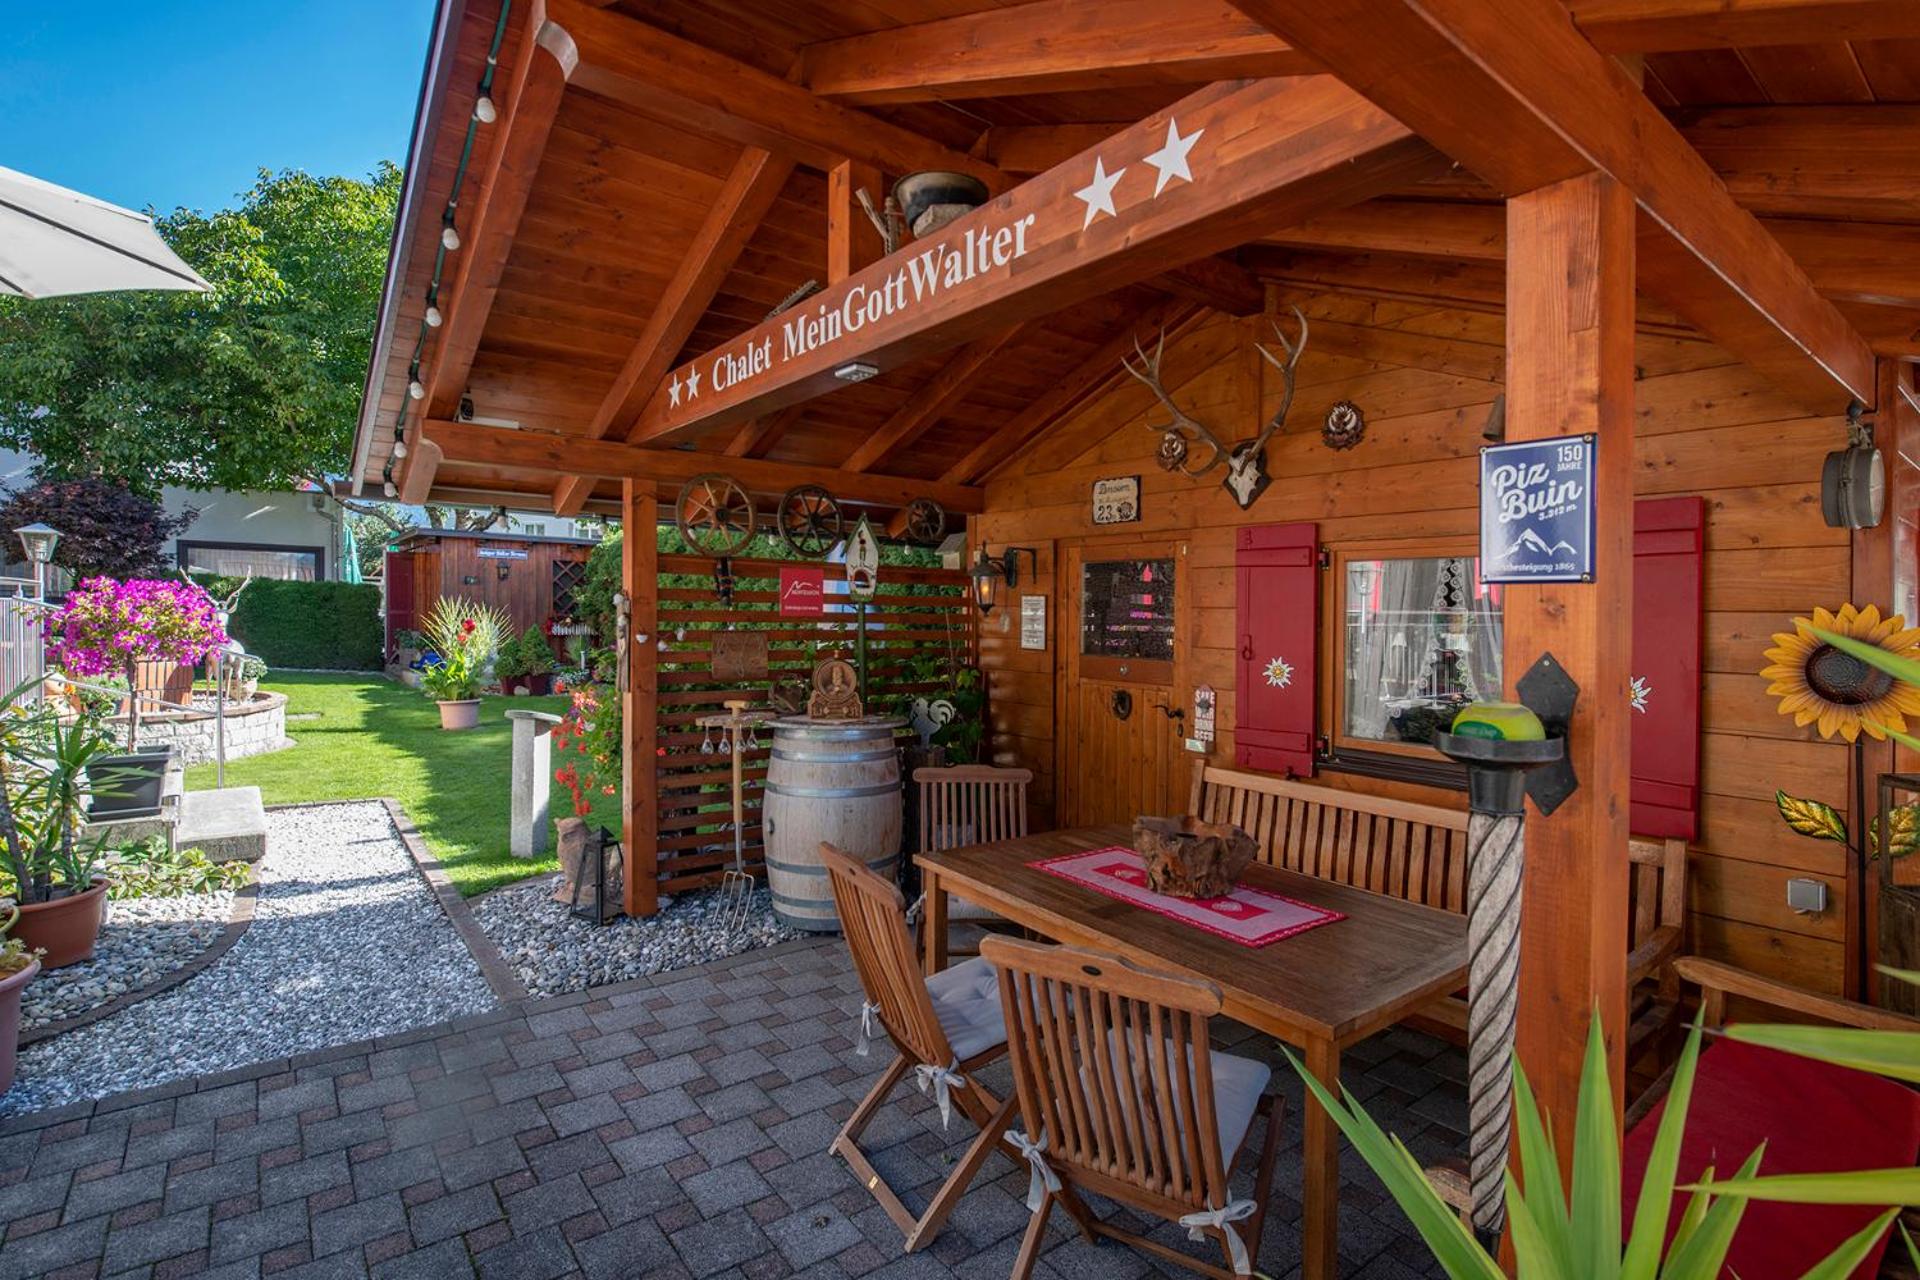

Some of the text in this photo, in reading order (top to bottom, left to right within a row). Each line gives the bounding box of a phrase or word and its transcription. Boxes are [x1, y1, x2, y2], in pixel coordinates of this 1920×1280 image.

[712, 213, 1036, 392] Chalet MeinGottWalter
[1557, 445, 1583, 463] 150
[1557, 461, 1583, 471] JAHRE
[1491, 463, 1550, 498] Piz
[1499, 480, 1583, 523] Buin
